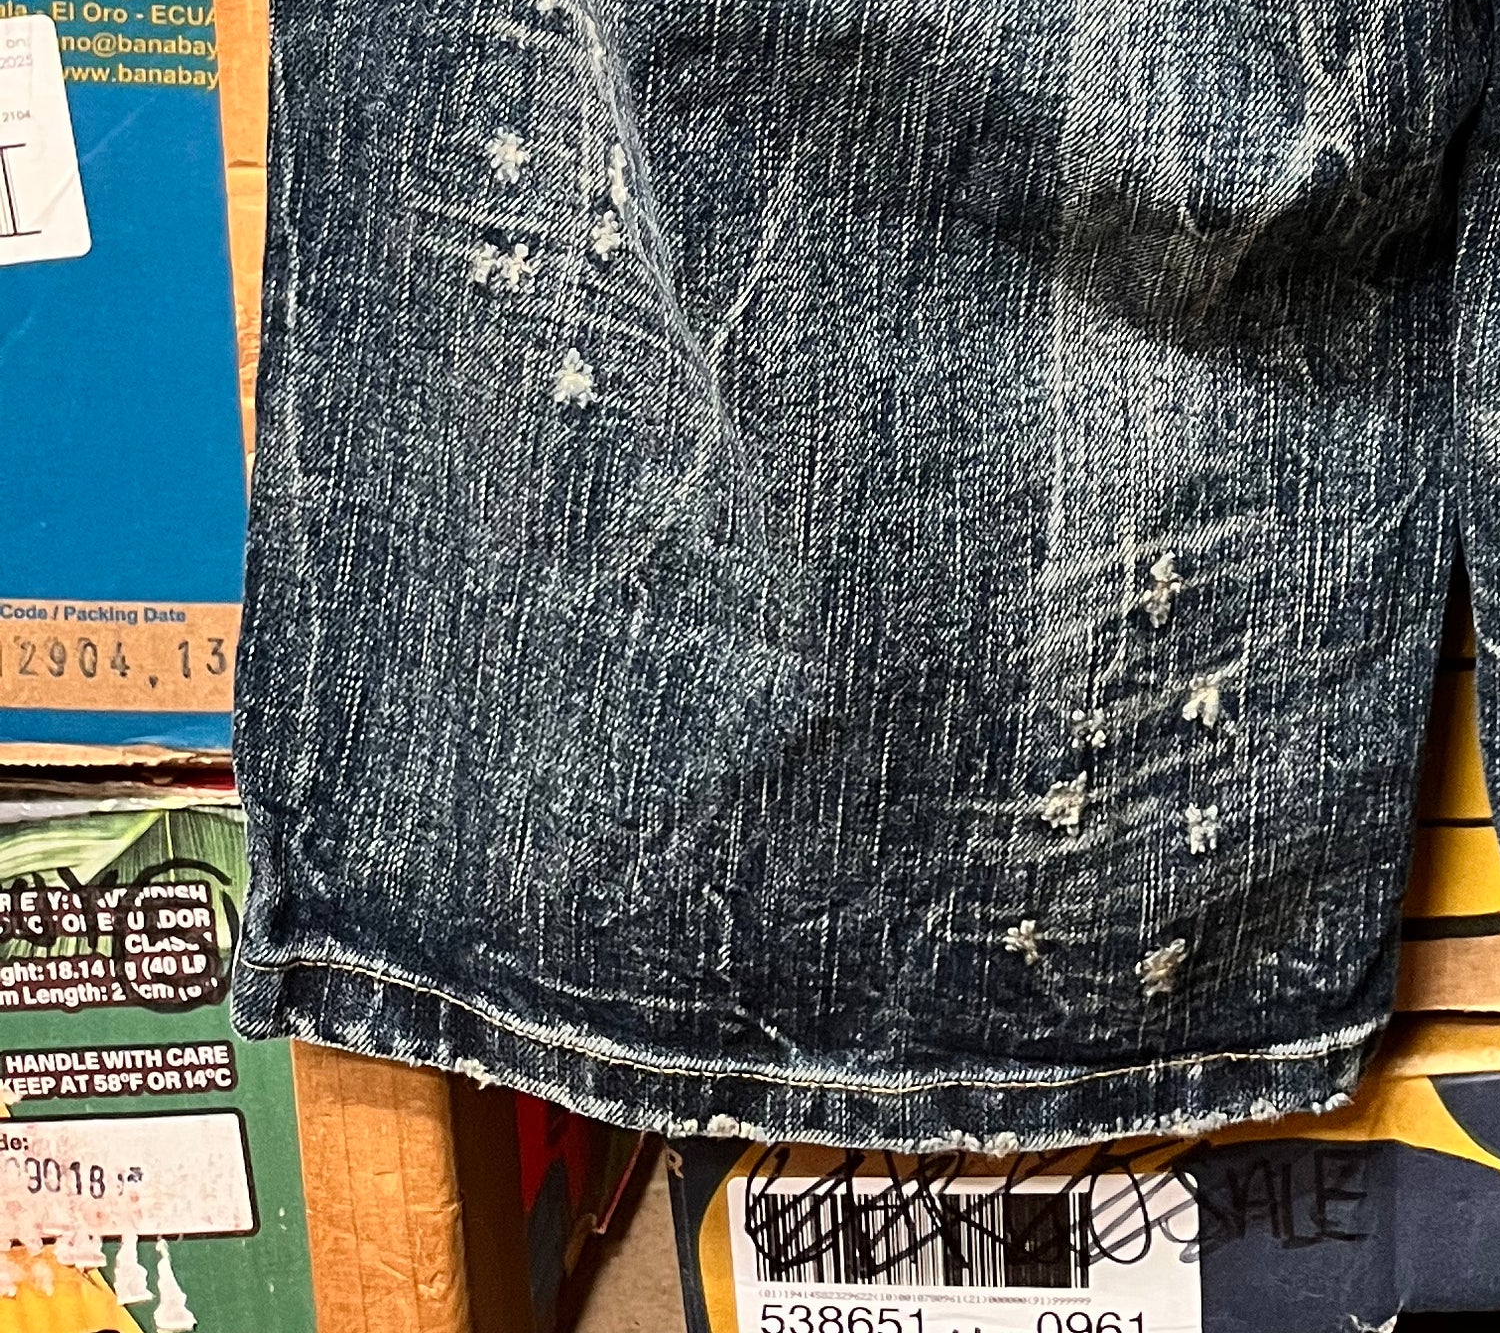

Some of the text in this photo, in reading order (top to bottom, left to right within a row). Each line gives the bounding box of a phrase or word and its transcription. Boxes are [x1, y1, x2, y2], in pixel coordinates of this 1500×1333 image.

[52, 0, 75, 22] El
[83, 2, 128, 24] Oro
[0, 604, 47, 621] Code
[63, 605, 138, 625] Packing
[144, 606, 187, 623] Date
[47, 958, 105, 981] 18.14
[23, 982, 108, 1008] Length:
[6, 1045, 230, 1074] HANDLE WITH CARE
[60, 1074, 89, 1094] AT
[147, 1070, 182, 1091] OR
